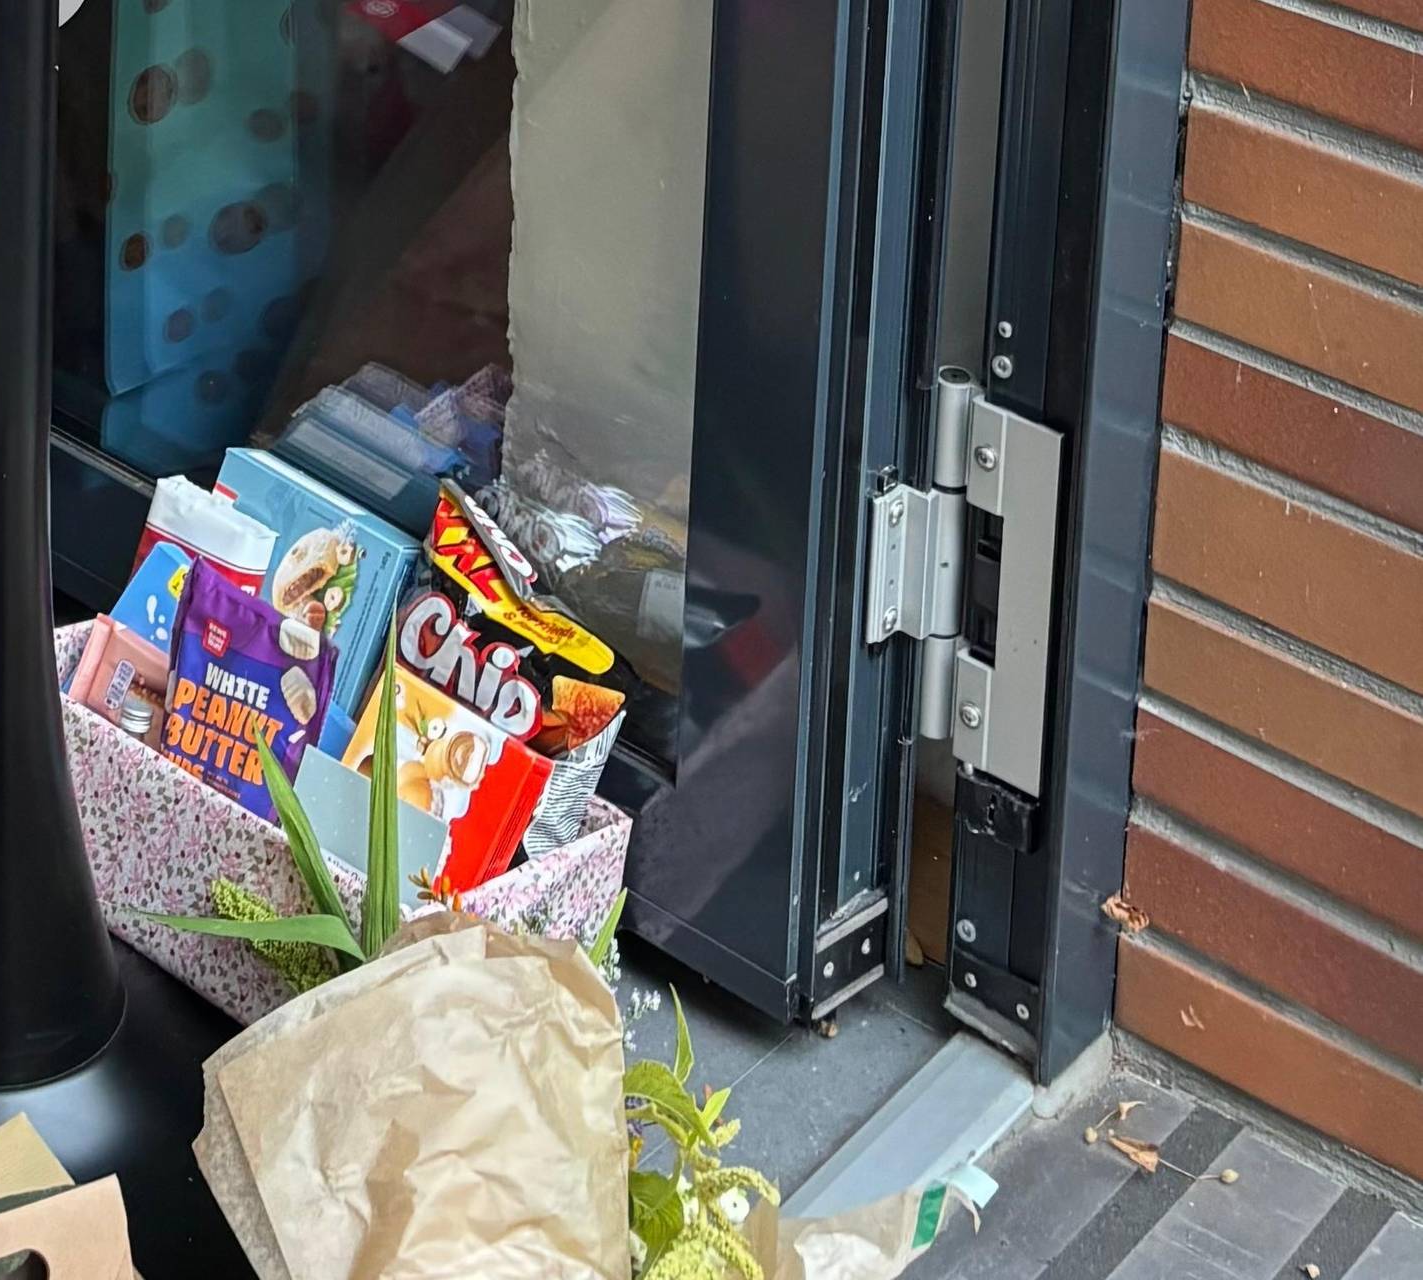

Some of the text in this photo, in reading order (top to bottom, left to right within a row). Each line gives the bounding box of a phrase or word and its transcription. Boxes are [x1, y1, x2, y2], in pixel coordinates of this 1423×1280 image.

[205, 662, 270, 710] WHITE
[400, 594, 539, 739] Chio
[174, 677, 284, 749] PEANUT
[166, 713, 264, 786] BUTTER
